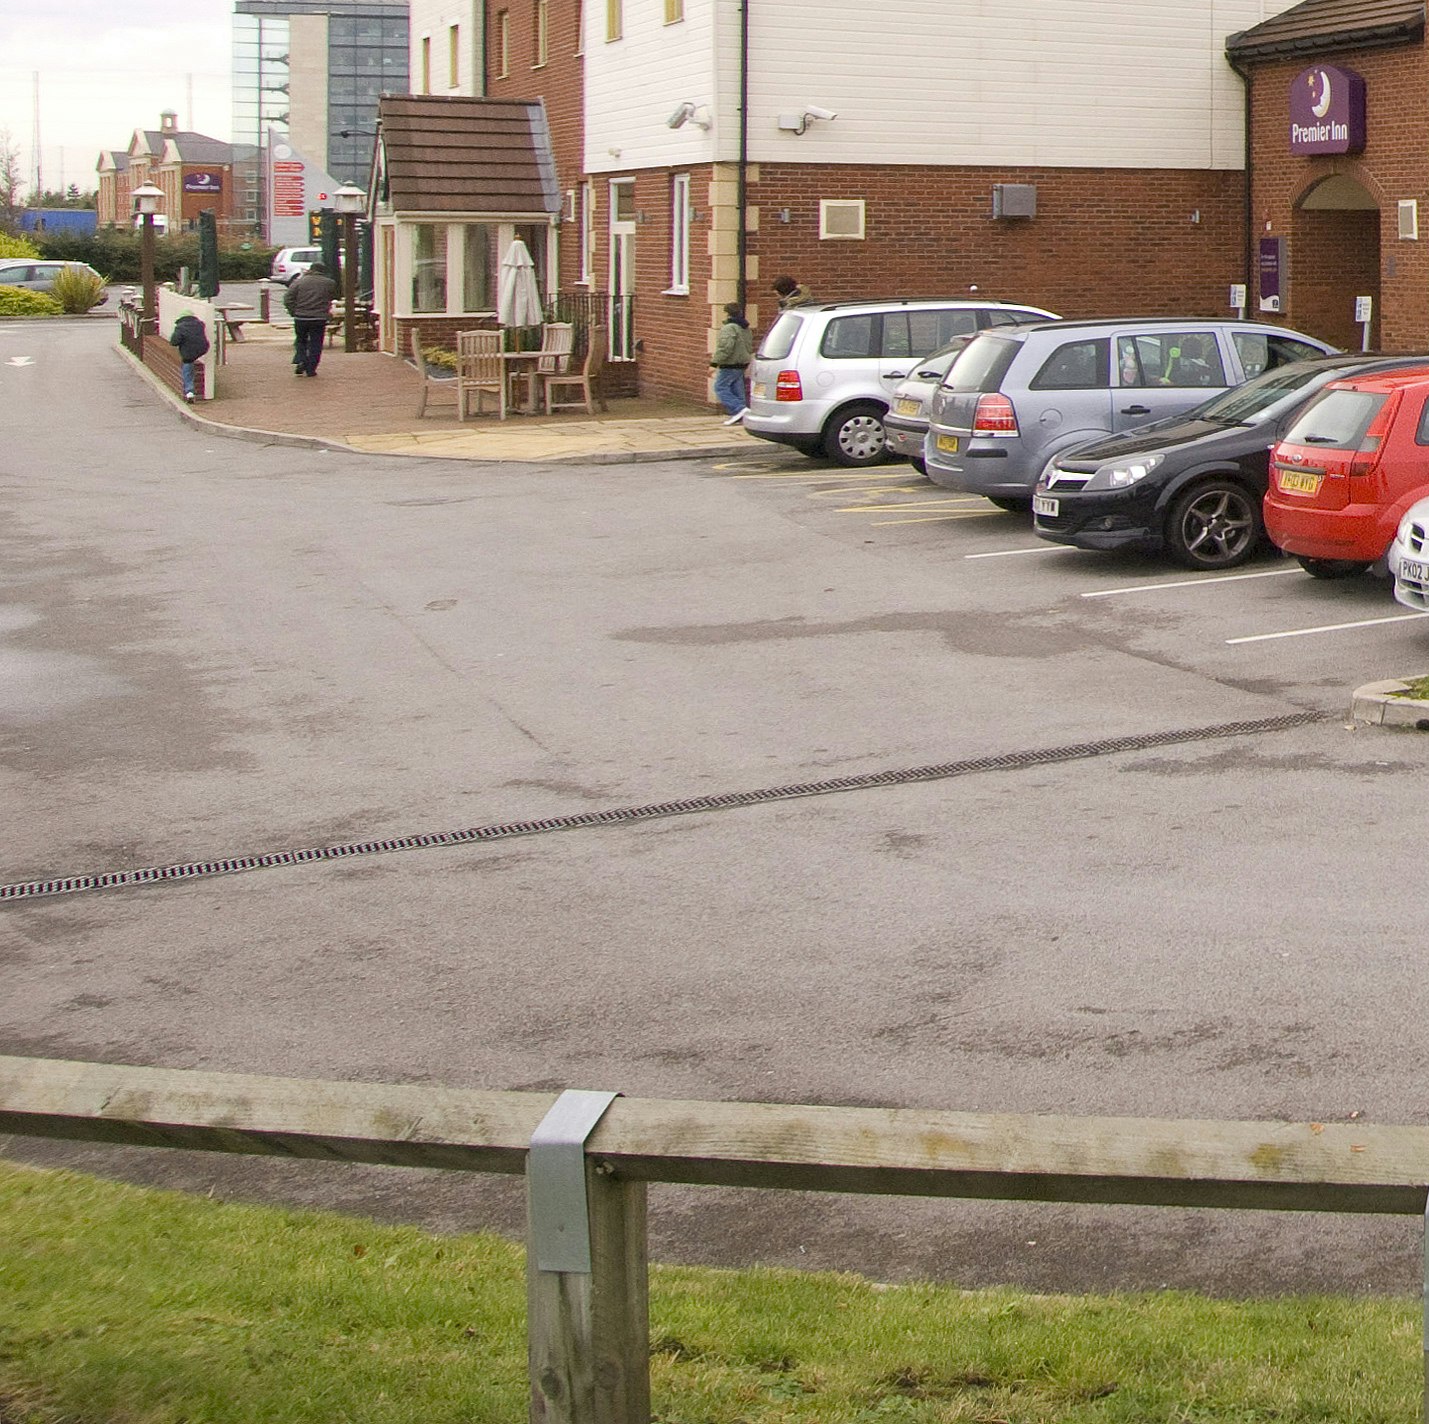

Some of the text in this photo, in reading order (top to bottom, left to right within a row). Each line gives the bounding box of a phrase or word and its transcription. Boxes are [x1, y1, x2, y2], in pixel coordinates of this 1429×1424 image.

[1292, 120, 1348, 144] Premier Inn
[1402, 561, 1423, 580] PK02
